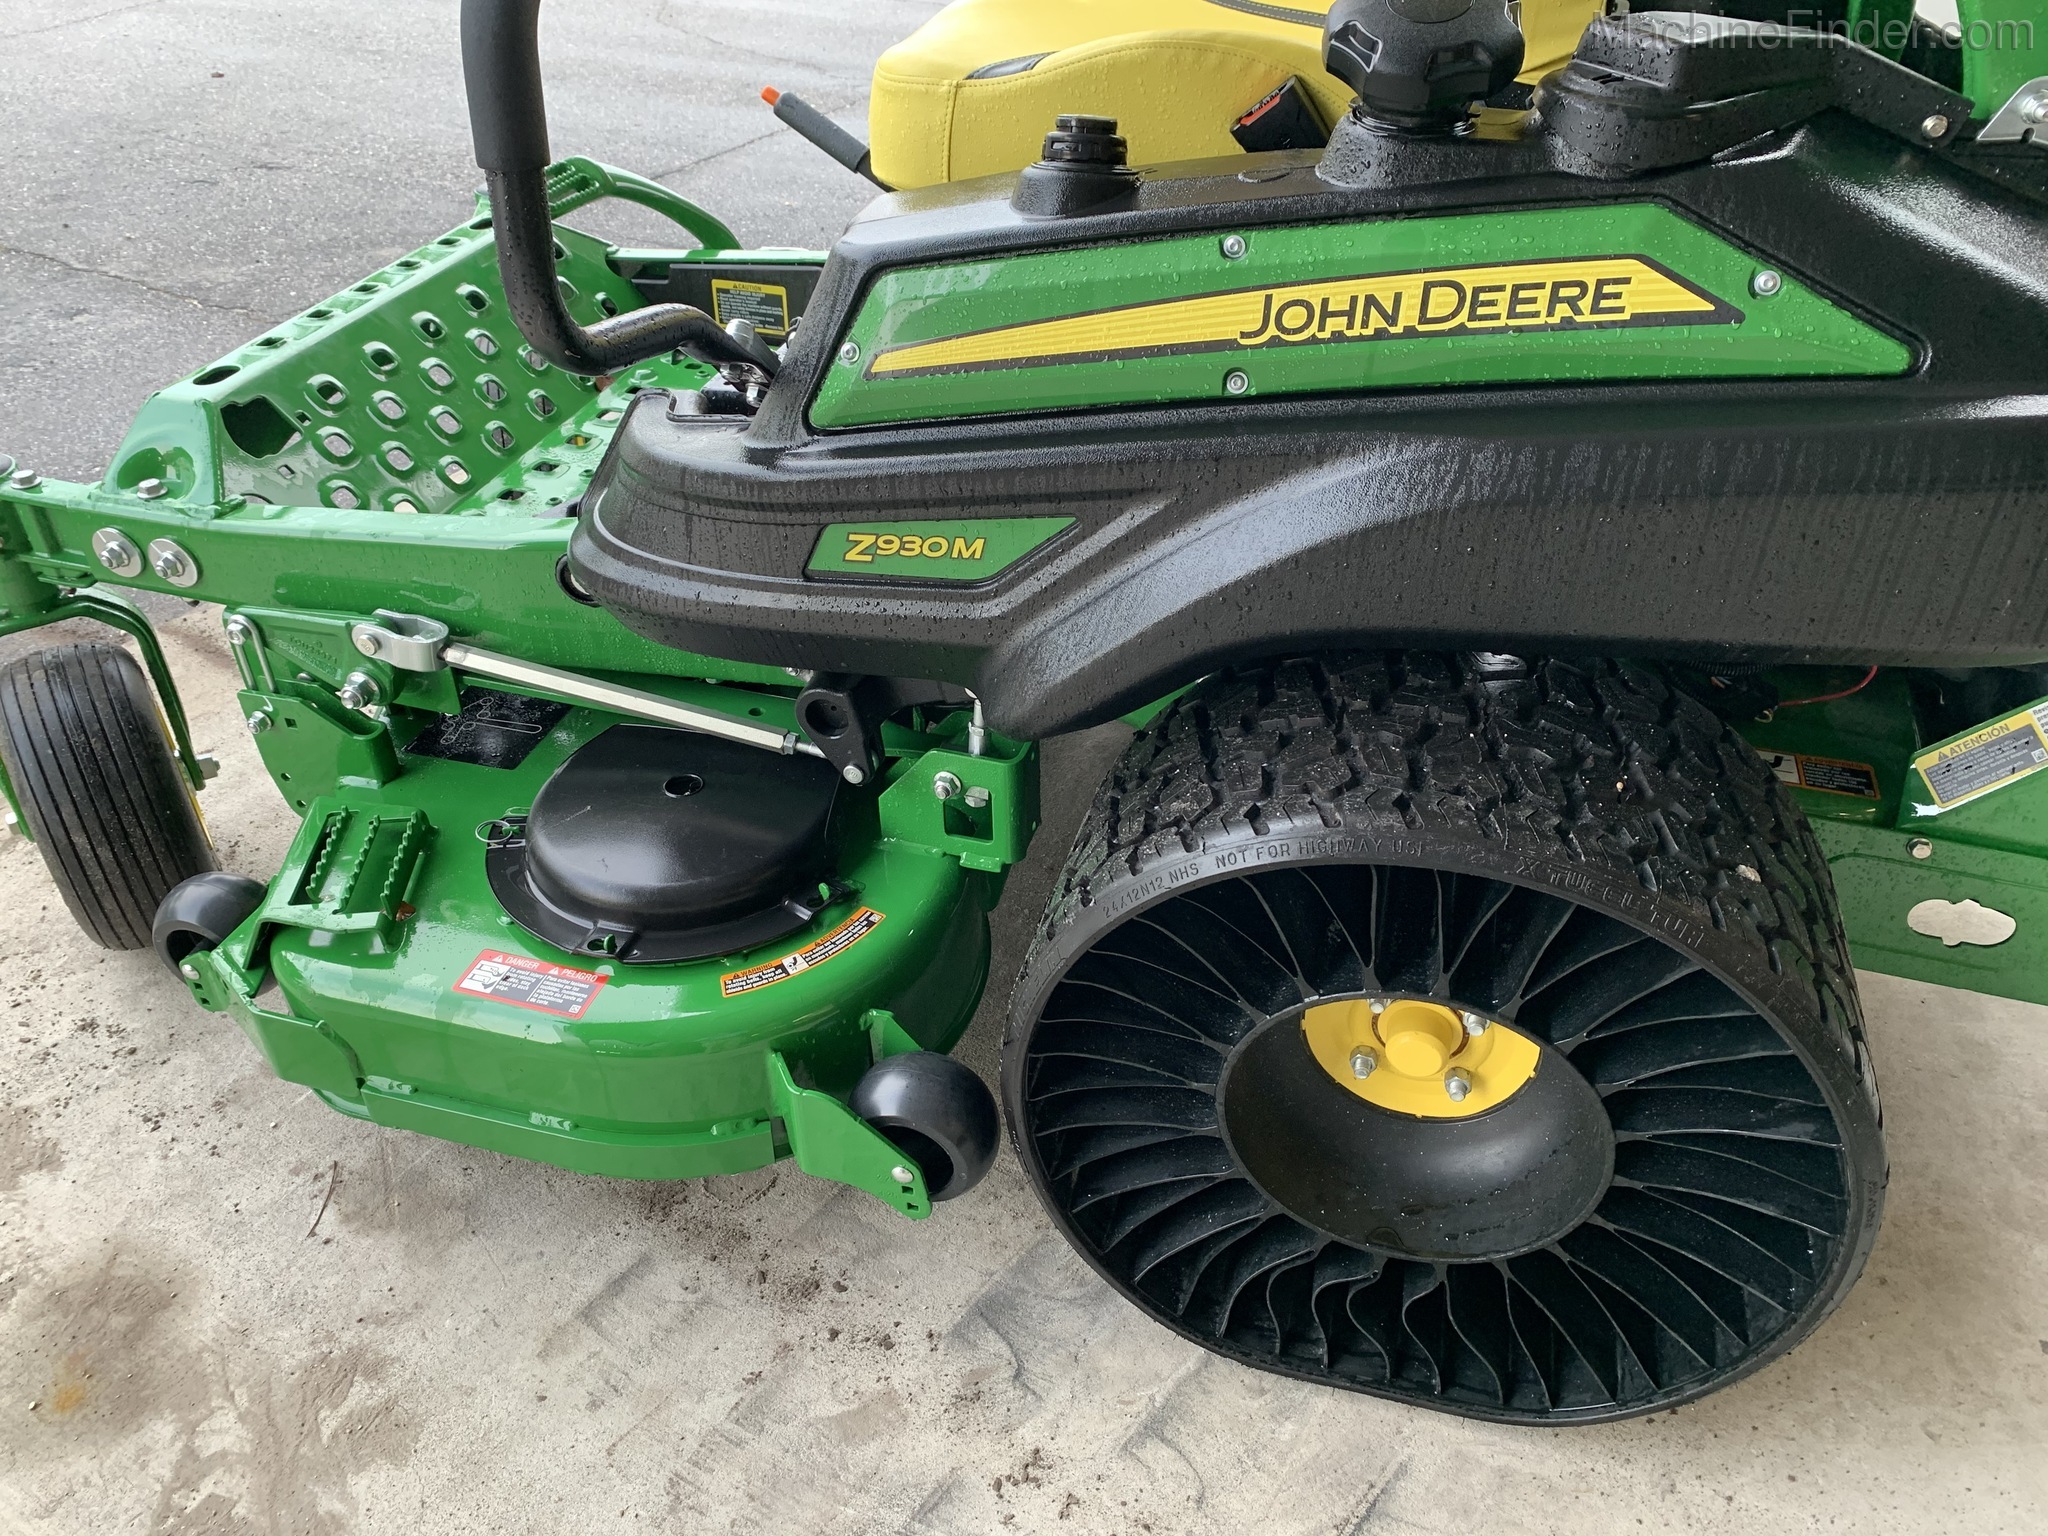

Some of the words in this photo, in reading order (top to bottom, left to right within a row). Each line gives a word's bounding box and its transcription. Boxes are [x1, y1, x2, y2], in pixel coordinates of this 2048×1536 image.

[1239, 291, 1403, 340] JOHN
[1419, 276, 1633, 326] DEERE
[842, 531, 986, 564] Z930M
[1949, 723, 2010, 756] ATENCIÓN
[1169, 862, 1200, 883] NHS
[1215, 848, 1248, 868] NOT
[1256, 843, 1290, 861] FOR
[1298, 836, 1382, 856] HIGHWAY
[820, 918, 855, 943] ADVERTENCIA
[505, 956, 540, 969] DANGER
[561, 968, 598, 982] PELIGRO
[740, 962, 773, 977] WARNING
